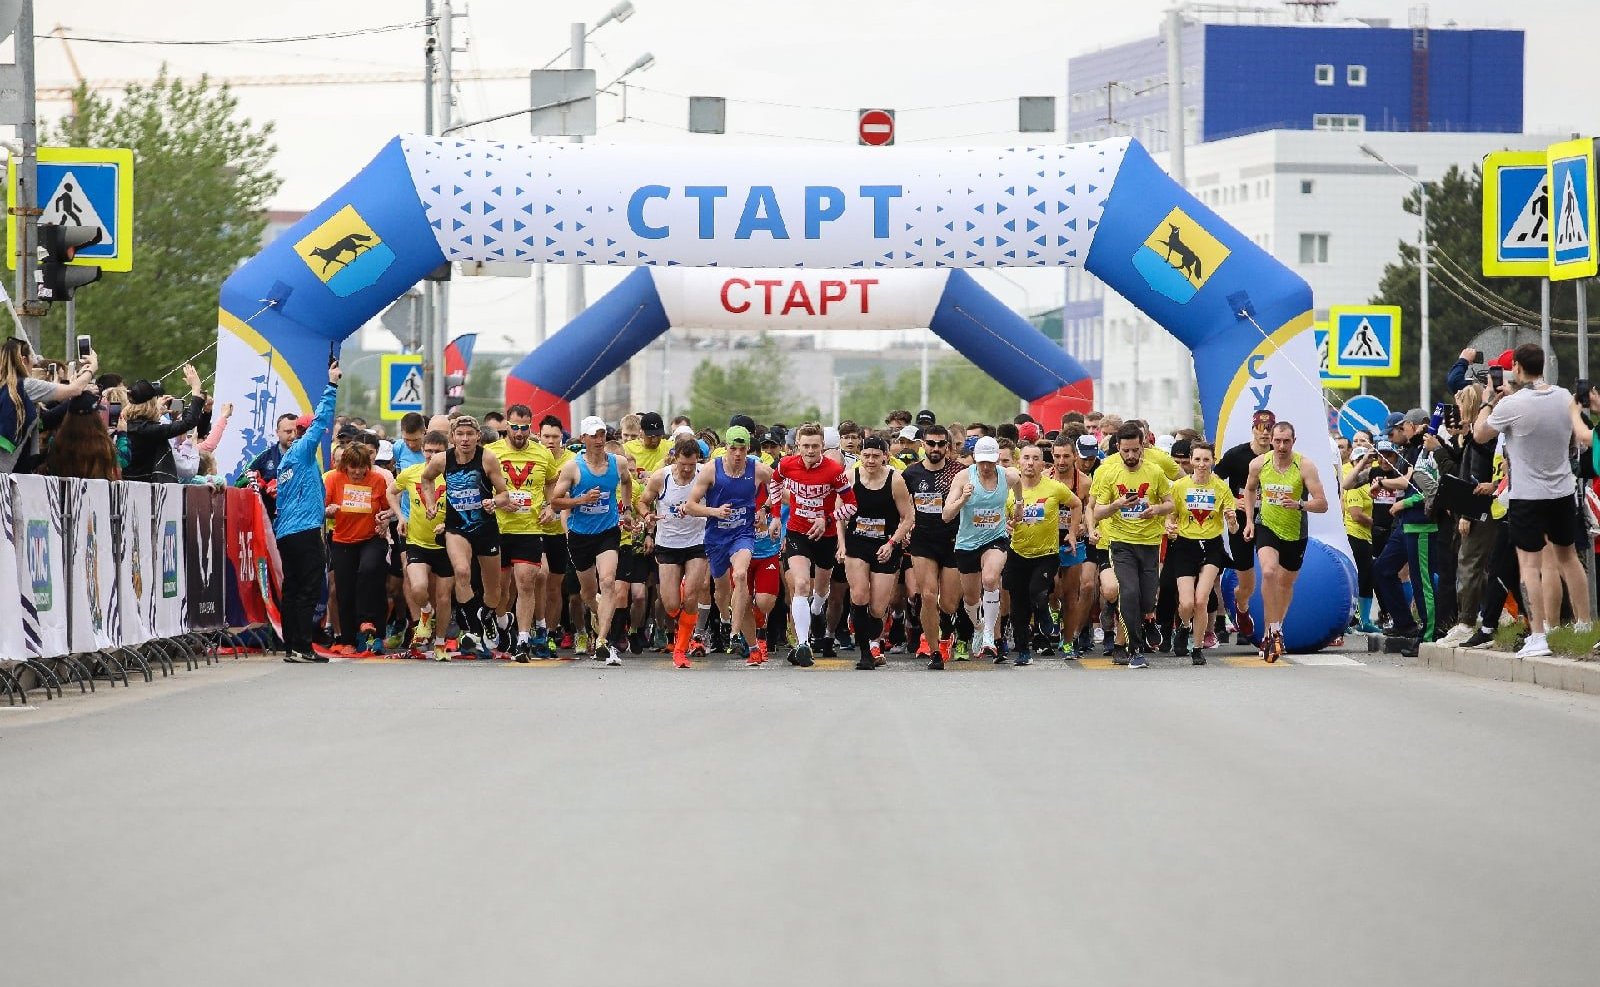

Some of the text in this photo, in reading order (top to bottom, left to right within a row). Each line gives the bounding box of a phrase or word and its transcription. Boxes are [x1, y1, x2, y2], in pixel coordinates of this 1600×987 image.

[626, 184, 908, 241] СТАРТ
[720, 278, 879, 316] СТАРТ
[1193, 495, 1209, 503] 374
